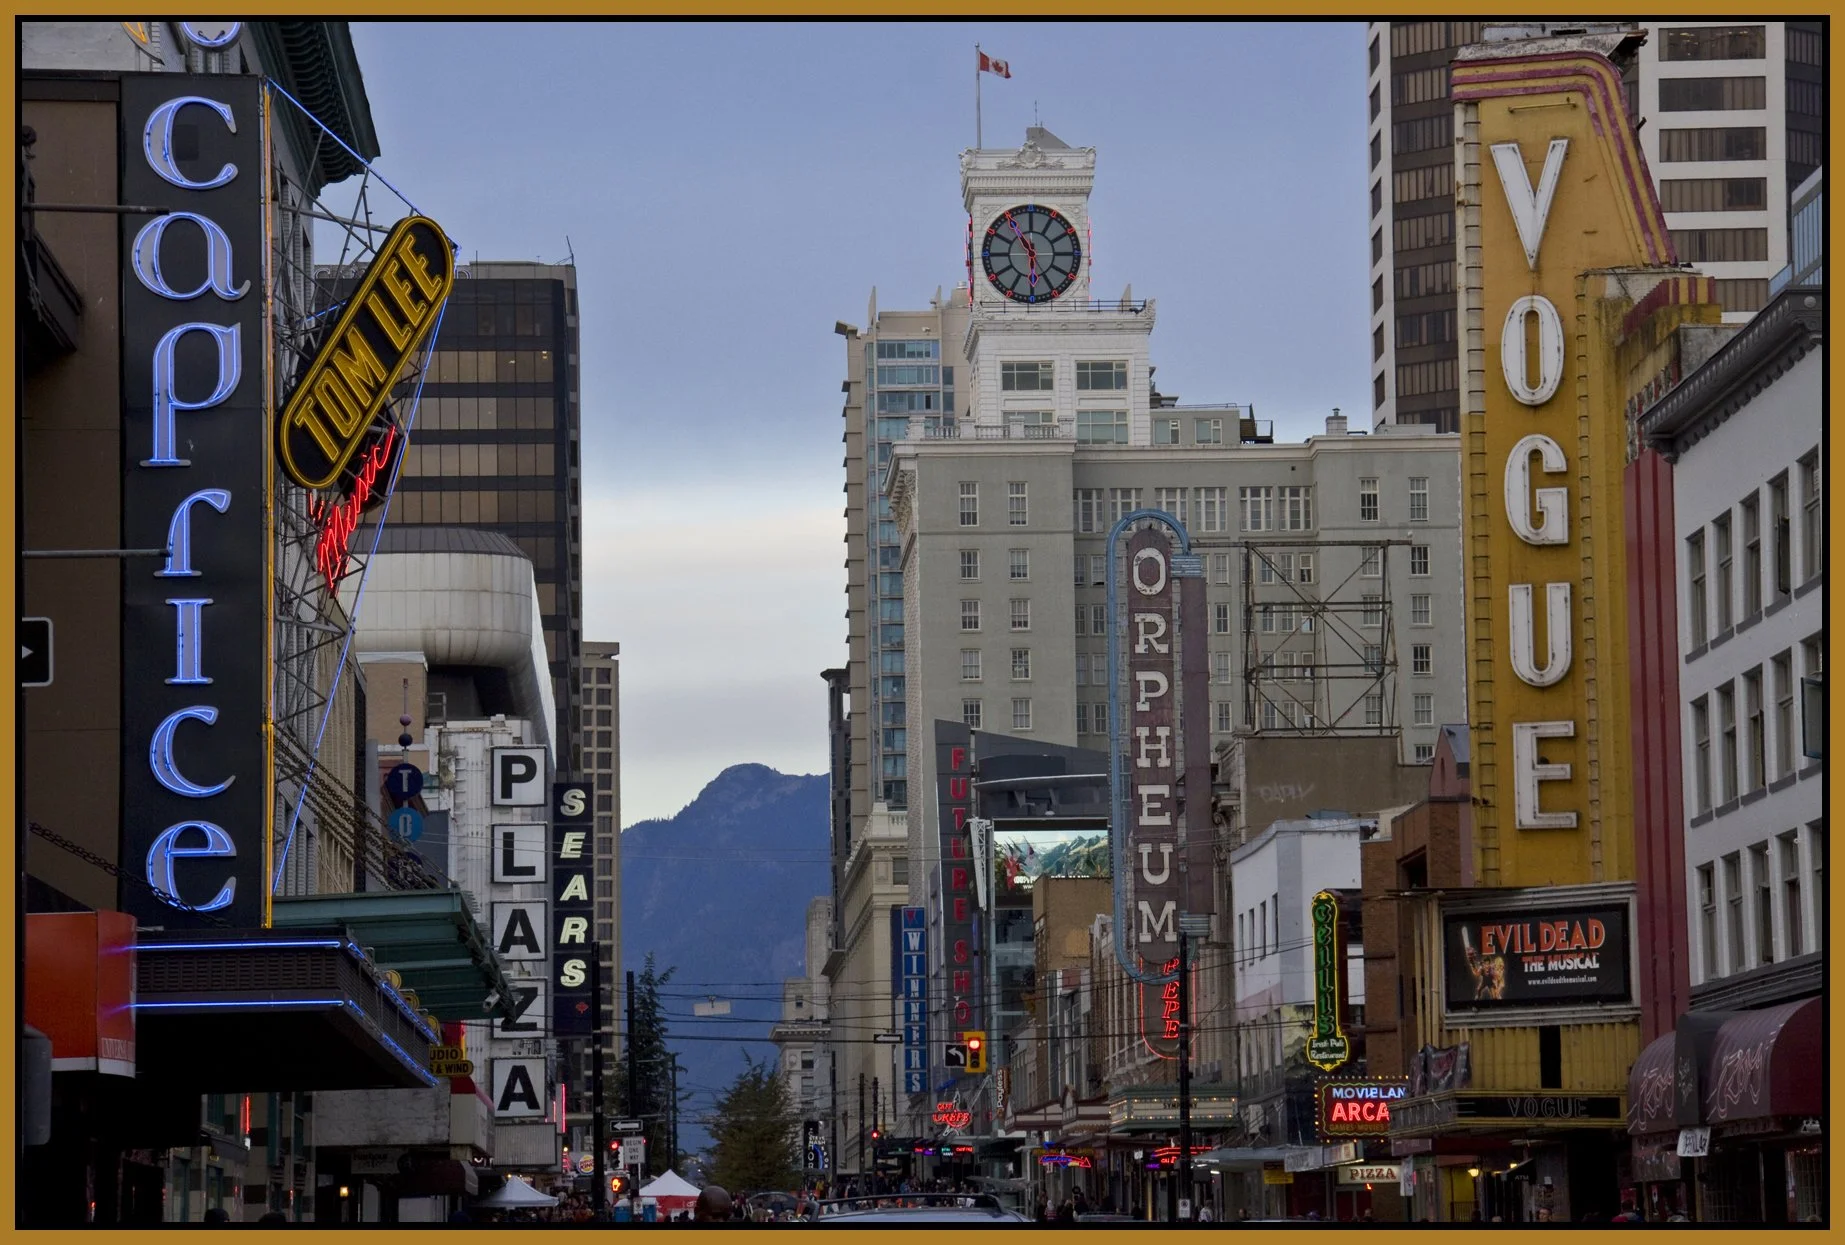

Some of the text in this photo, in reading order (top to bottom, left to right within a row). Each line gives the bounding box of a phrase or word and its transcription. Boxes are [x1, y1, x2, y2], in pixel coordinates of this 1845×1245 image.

[294, 322, 389, 462] TOM
[365, 232, 442, 352] LEE
[317, 424, 396, 591] Music
[1490, 138, 1578, 832] VOGUE
[1132, 546, 1178, 943] ORPHEUM
[560, 788, 589, 987] SEARS
[951, 747, 968, 921] FUTURE
[498, 754, 542, 1111] PLAZA
[906, 931, 922, 1092] WINNERS
[1480, 917, 1605, 955] EVIL DEAD
[1521, 952, 1600, 972] THE MUSICAL
[445, 1063, 469, 1074] WIND
[1162, 1102, 1198, 1110] SYMPNY
[1332, 1101, 1390, 1121] ARCA
[1507, 1096, 1591, 1119] VOGUE
[1350, 1168, 1397, 1180] PIZZA
